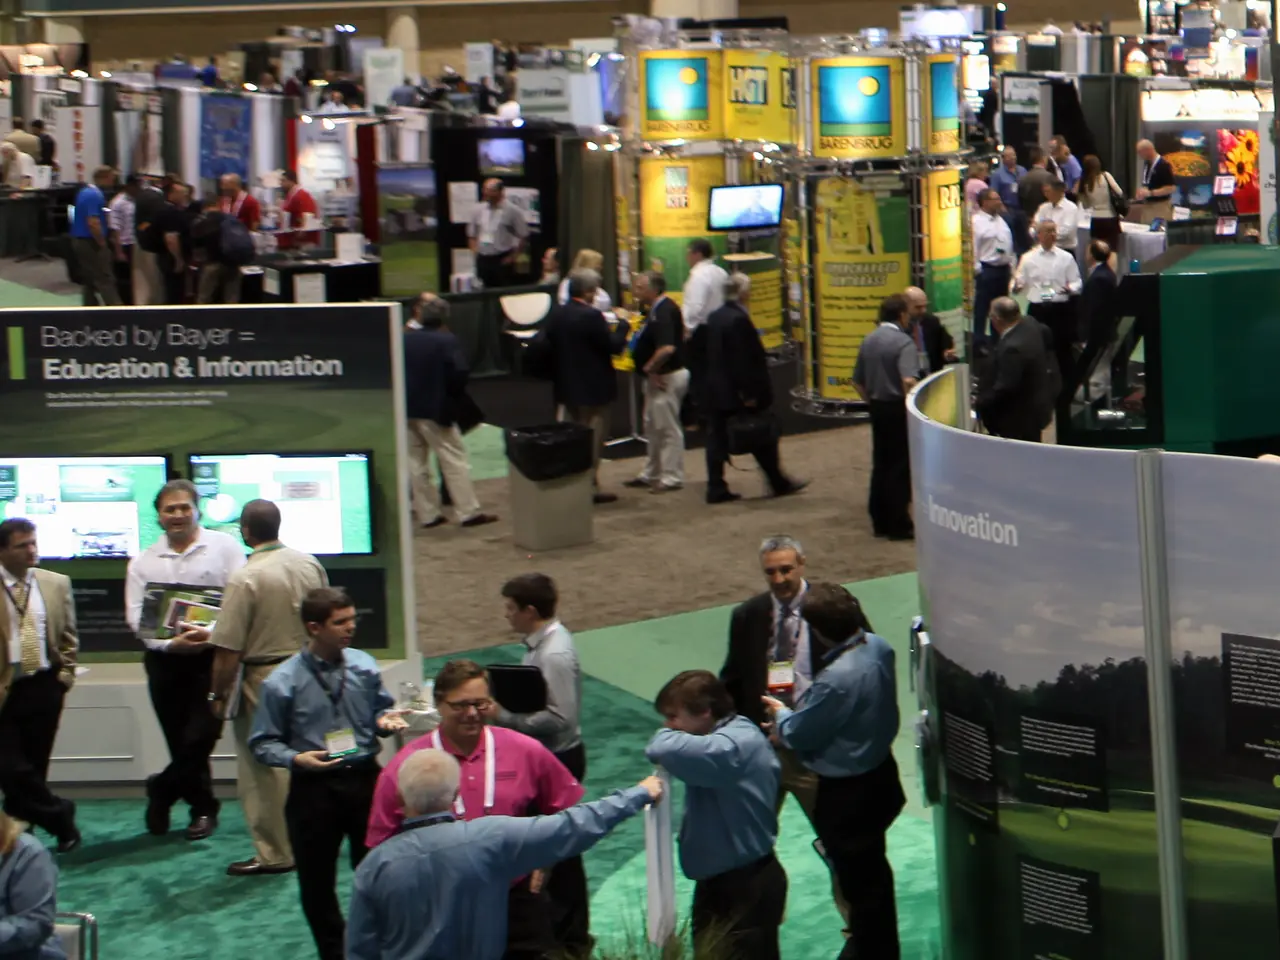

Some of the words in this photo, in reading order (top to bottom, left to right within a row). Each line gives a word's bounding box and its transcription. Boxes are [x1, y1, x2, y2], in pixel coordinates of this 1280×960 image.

[819, 137, 893, 149] BARENBRUG
[40, 325, 127, 347] Backed
[133, 325, 162, 350] by
[166, 323, 234, 350] Bayer
[42, 357, 169, 380] Education
[173, 355, 194, 378] &
[198, 354, 343, 377] Information
[929, 494, 1018, 547] Innovation
